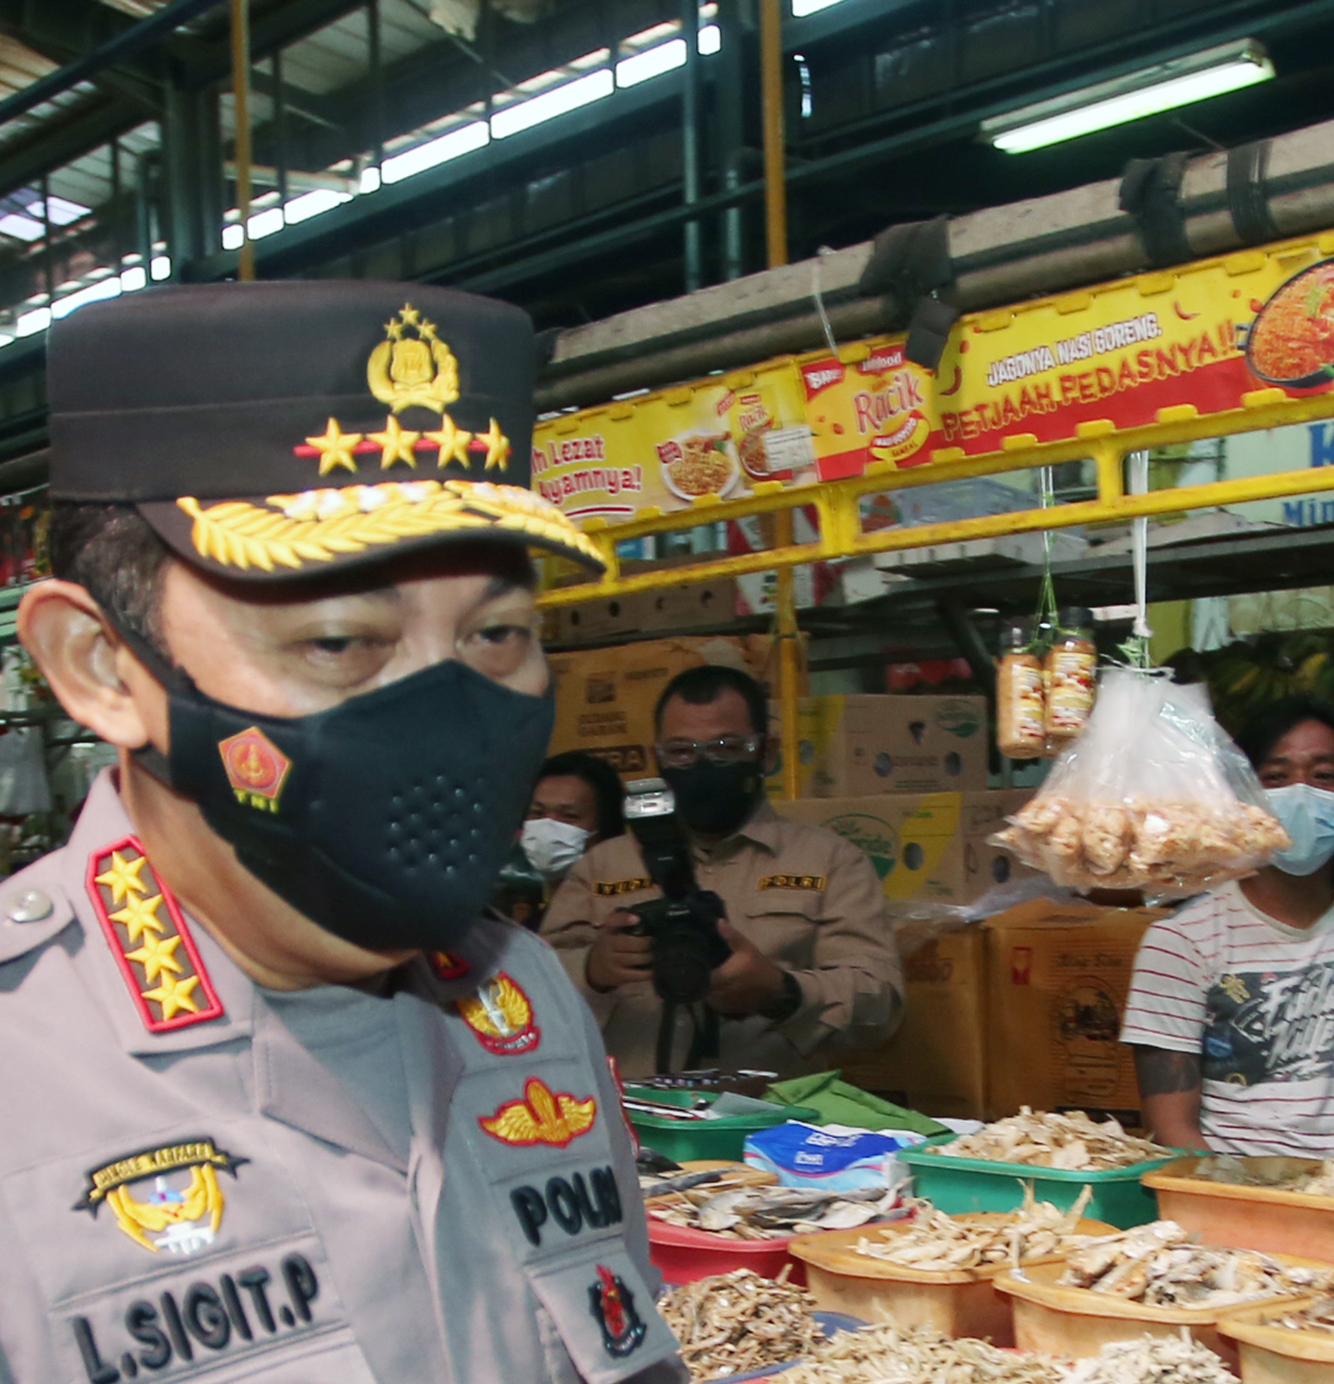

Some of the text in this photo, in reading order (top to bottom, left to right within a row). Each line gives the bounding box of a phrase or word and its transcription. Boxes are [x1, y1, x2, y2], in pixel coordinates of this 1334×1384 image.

[940, 318, 1237, 441] PETJAAH PEDASNYA!!
[987, 311, 1162, 387] JAGONYA NASI GORENG.
[854, 371, 924, 434] Racik
[547, 436, 605, 467] Lezat
